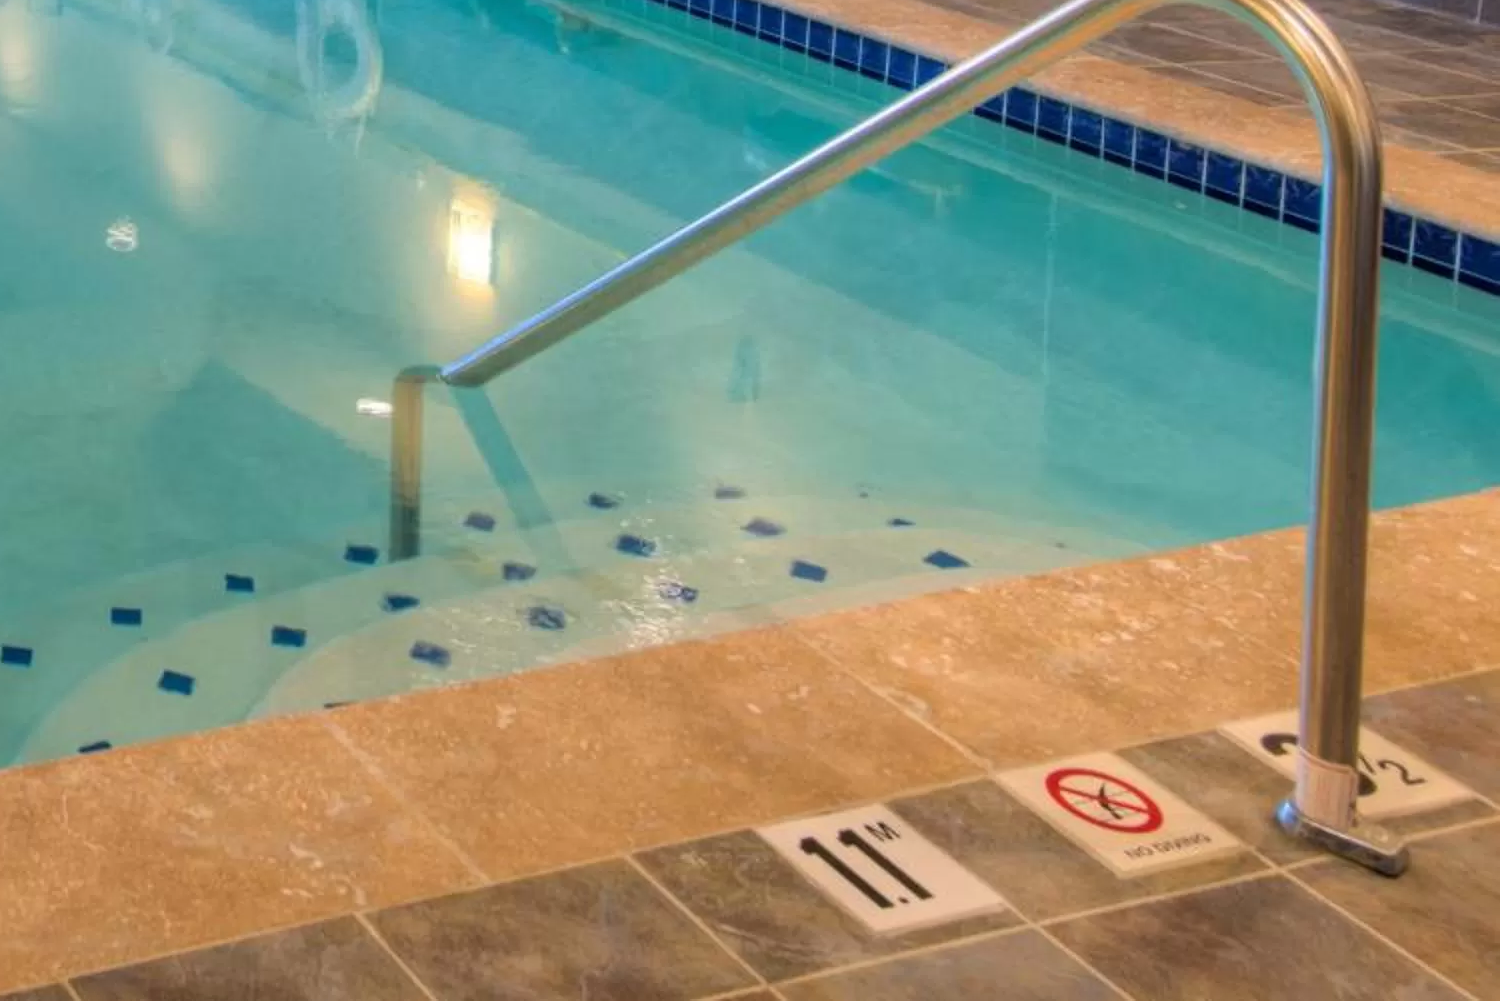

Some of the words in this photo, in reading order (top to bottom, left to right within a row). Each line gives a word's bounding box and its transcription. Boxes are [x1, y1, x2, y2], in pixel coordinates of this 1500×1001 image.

[863, 820, 902, 843] M
[1123, 845, 1154, 859] NO
[1152, 832, 1212, 854] DIVING
[799, 828, 934, 909] 1.1
